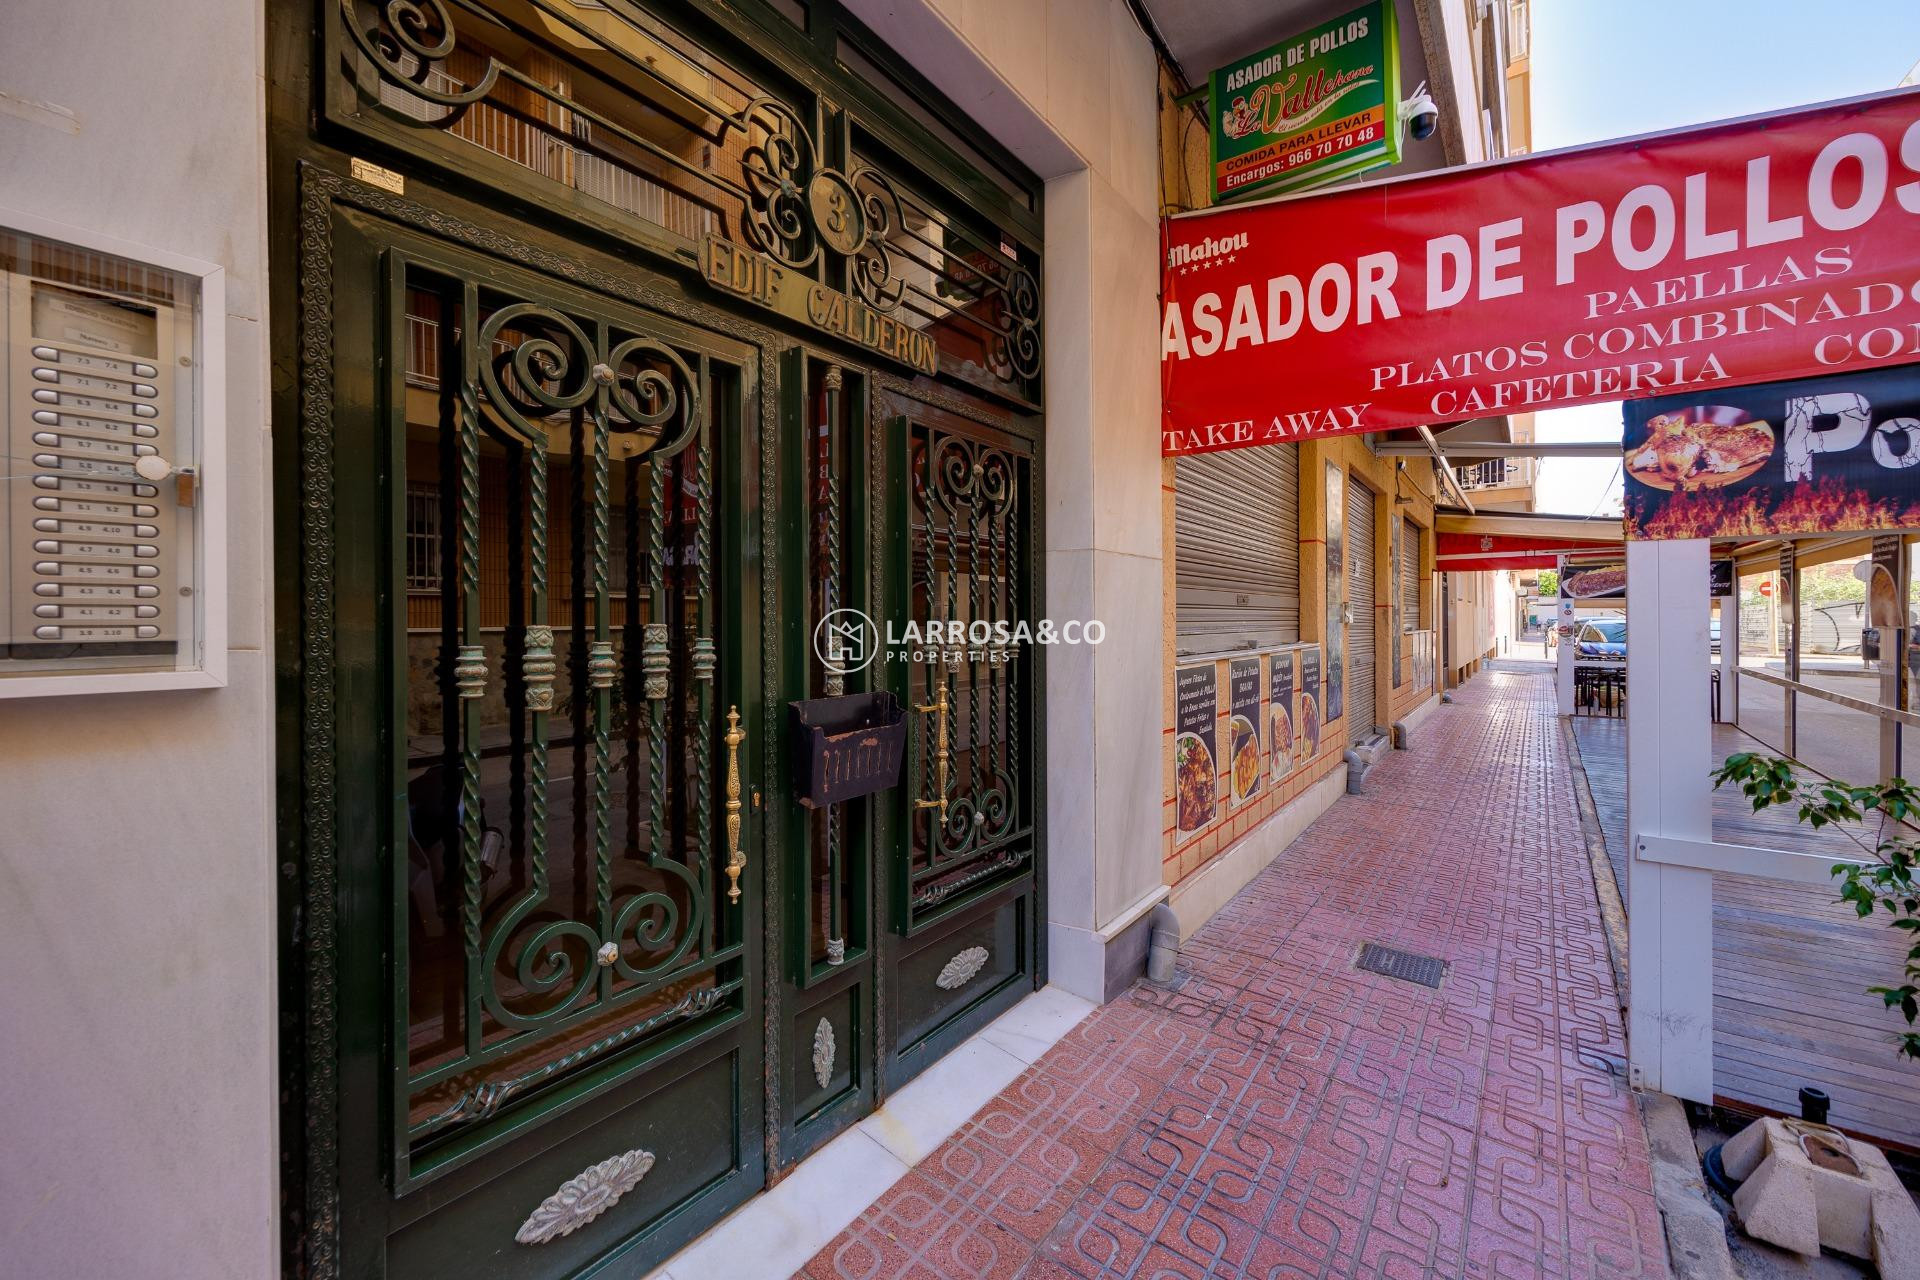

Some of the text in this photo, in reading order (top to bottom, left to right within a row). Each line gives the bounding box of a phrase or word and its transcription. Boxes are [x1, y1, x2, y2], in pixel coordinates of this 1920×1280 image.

[1226, 17, 1369, 93] ASADOR DE POLLOS
[1226, 113, 1372, 171] COMIDA PARA LLEVAR
[1226, 127, 1374, 188] Encargos: 966 70 70 48
[827, 191, 848, 232] 3
[1168, 232, 1249, 268] Mahou
[706, 236, 937, 376] EDIF CALDERON
[1161, 251, 1401, 362] ASADOR
[1427, 217, 1524, 311] DE
[1583, 245, 1854, 320] PAELLAS
[1370, 280, 1920, 392] PLATOS COMBINAD
[1430, 352, 1732, 416] CAFETERIA
[1163, 403, 1372, 452] TAKE AWAY
